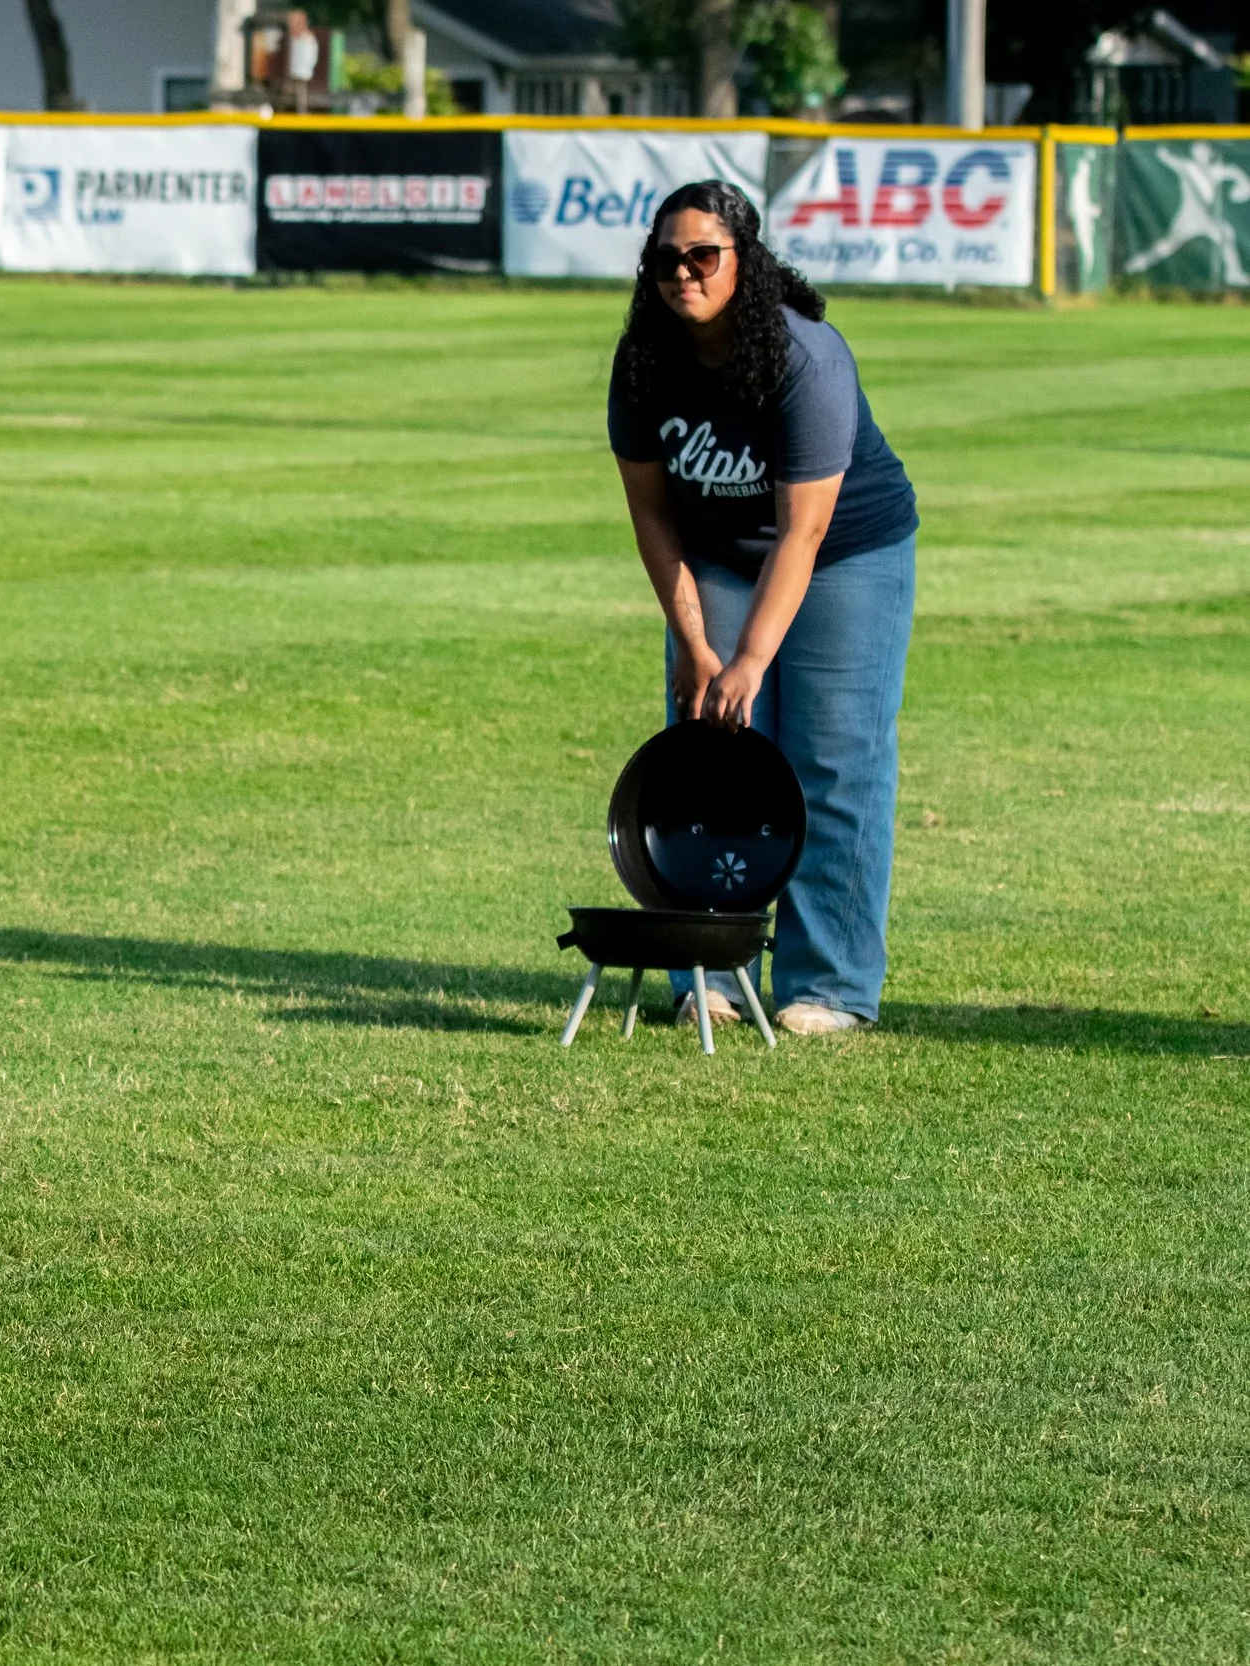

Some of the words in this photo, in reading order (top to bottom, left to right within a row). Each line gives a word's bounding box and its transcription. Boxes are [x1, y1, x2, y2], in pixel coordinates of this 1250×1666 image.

[76, 168, 247, 204] PARMENTER
[267, 175, 486, 209] LANGLOIS
[555, 176, 657, 227] Belt
[784, 149, 1011, 229] ABC
[787, 236, 884, 267] Supply
[898, 238, 942, 264] Co.
[659, 416, 767, 497] Clips
[713, 480, 773, 498] BASEBALL
